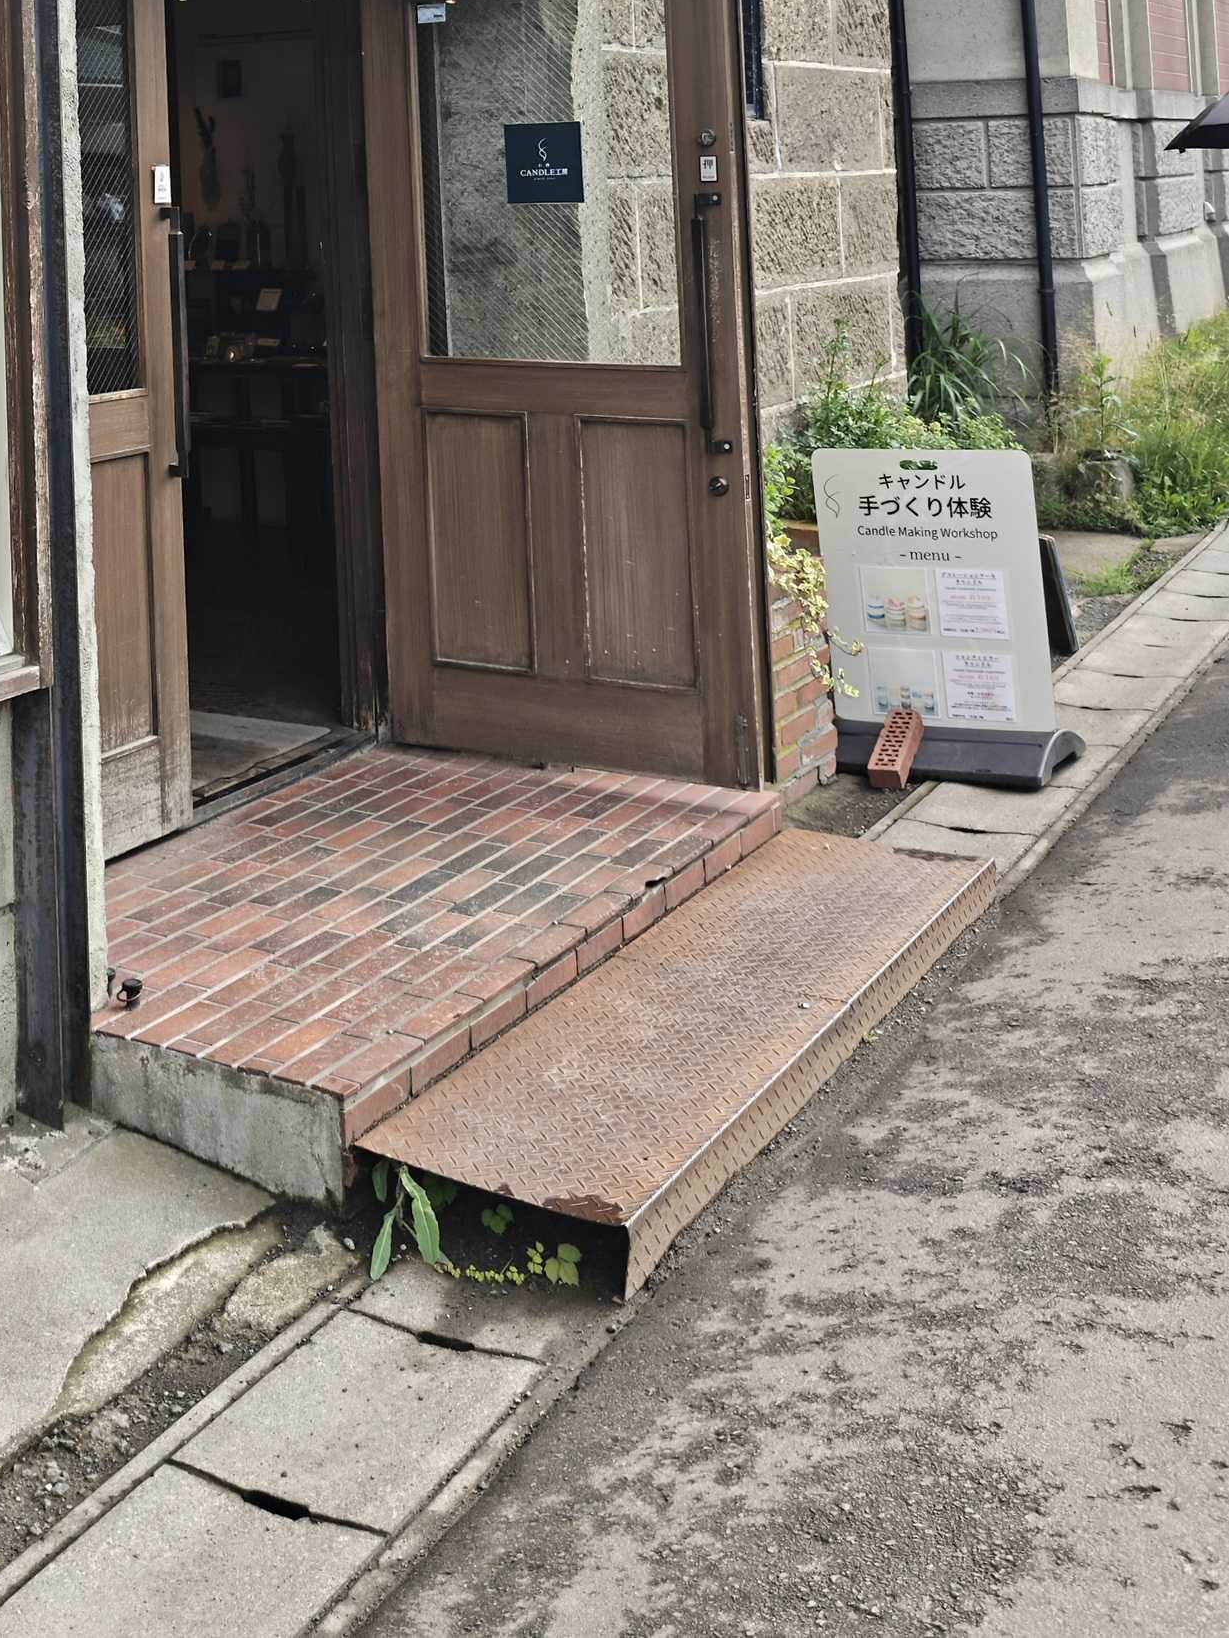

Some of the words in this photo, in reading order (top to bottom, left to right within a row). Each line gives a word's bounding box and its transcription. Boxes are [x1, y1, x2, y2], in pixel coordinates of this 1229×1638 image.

[879, 473, 966, 490] キャンドル
[858, 495, 993, 519] 手づくり体験
[857, 525, 896, 537] Candle
[898, 526, 939, 540] Making
[940, 527, 998, 542] Workshop
[909, 550, 950, 561] menu
